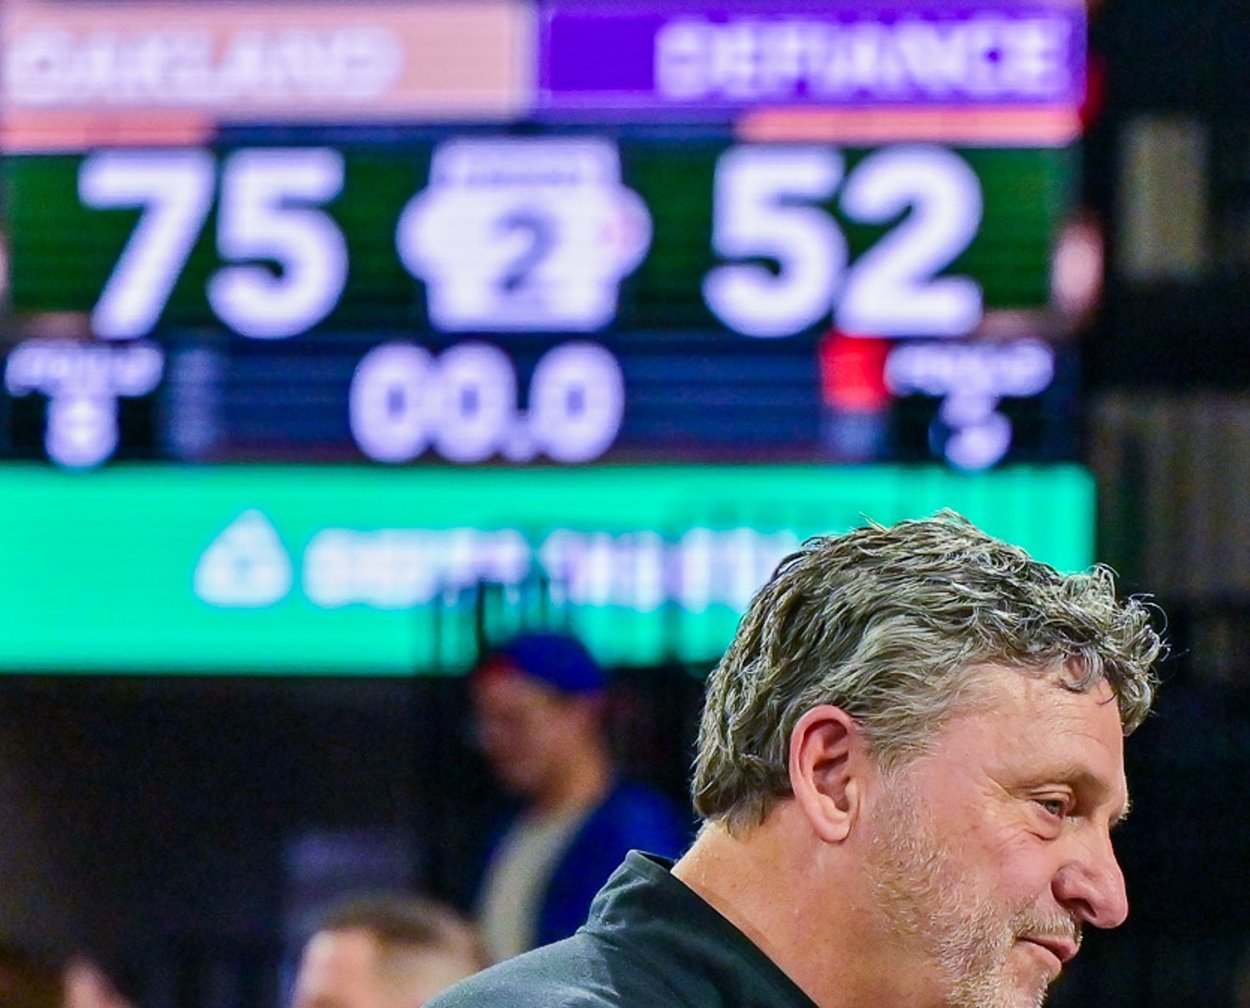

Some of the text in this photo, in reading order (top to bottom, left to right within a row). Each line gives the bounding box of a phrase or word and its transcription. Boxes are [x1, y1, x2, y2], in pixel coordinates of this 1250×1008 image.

[653, 18, 1075, 98] DEFIANCE
[78, 146, 348, 338] 75
[494, 207, 562, 314] 2
[703, 146, 985, 338] 52
[349, 343, 625, 463] 00.0
